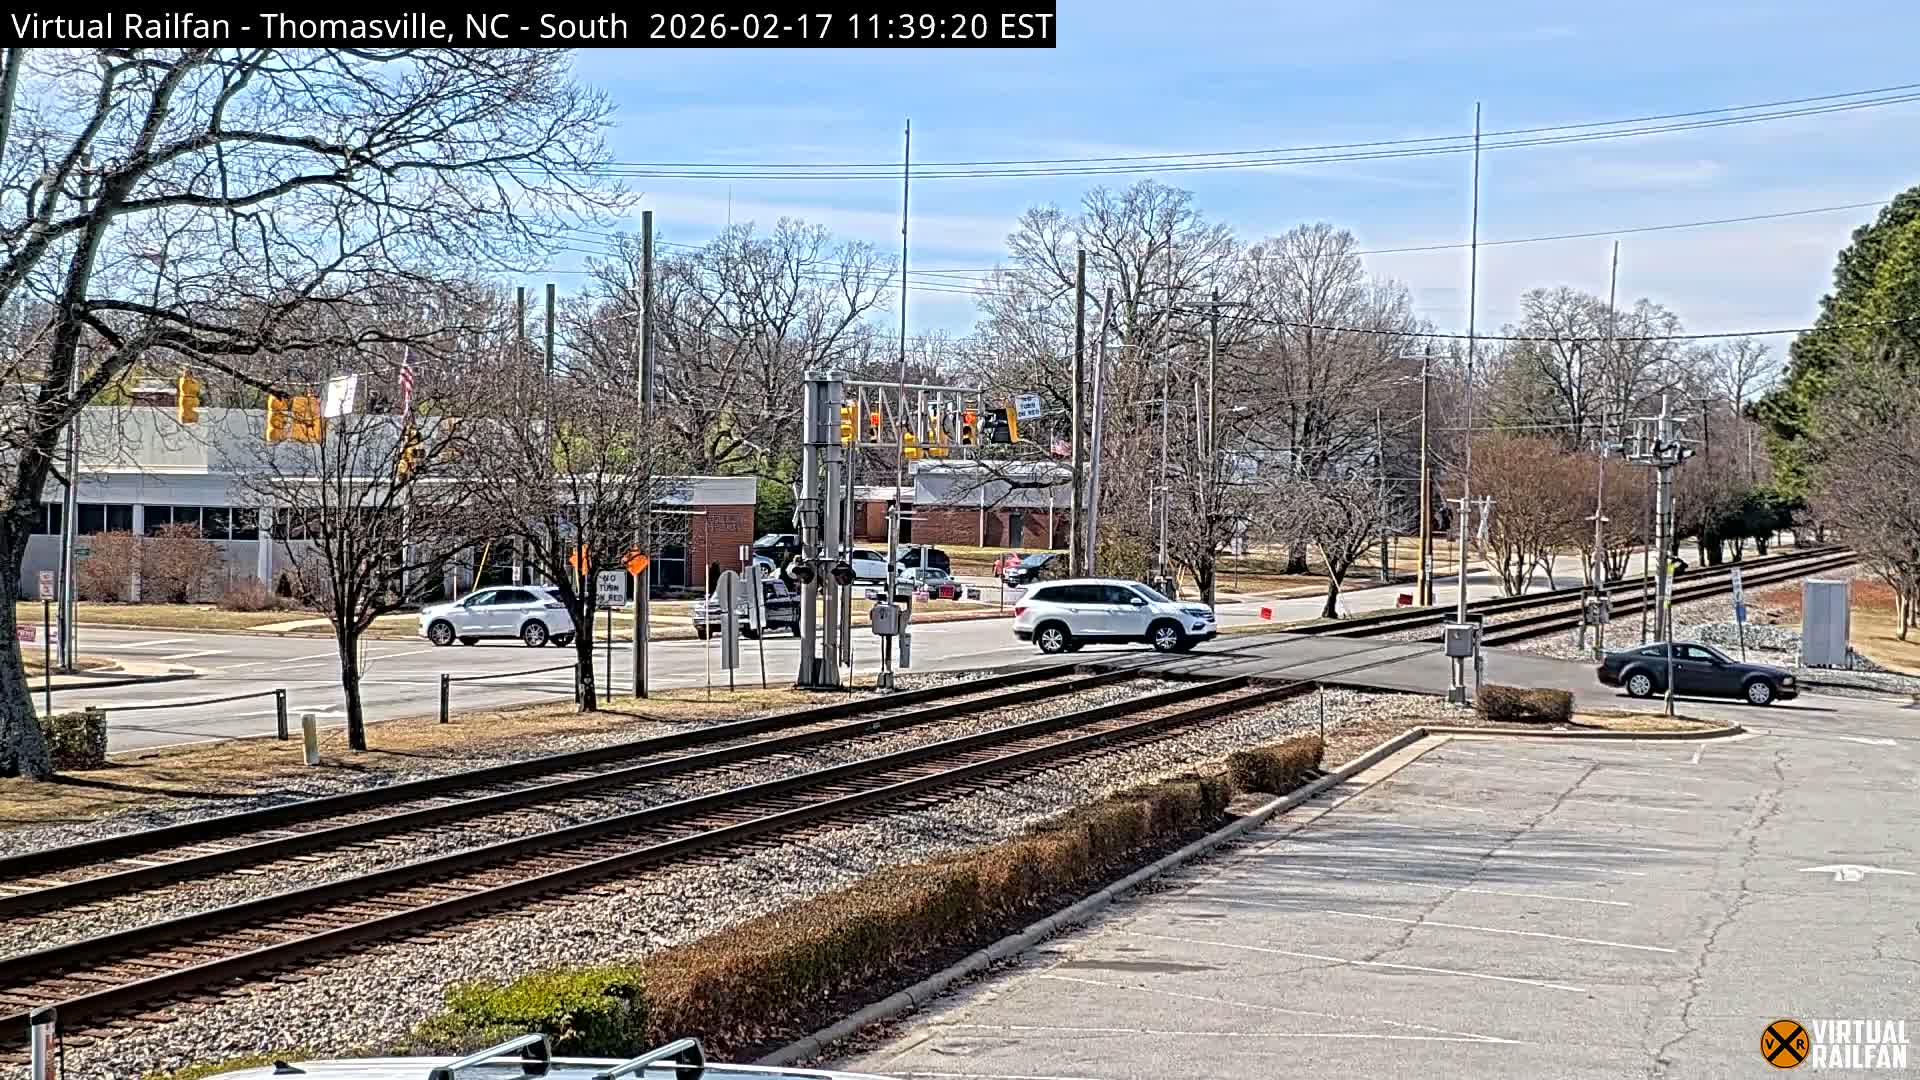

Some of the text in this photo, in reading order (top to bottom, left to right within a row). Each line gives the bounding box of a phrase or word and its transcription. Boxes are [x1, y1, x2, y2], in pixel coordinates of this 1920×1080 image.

[602, 574, 617, 582] NO
[600, 584, 620, 592] TURN
[608, 594, 624, 602] RED
